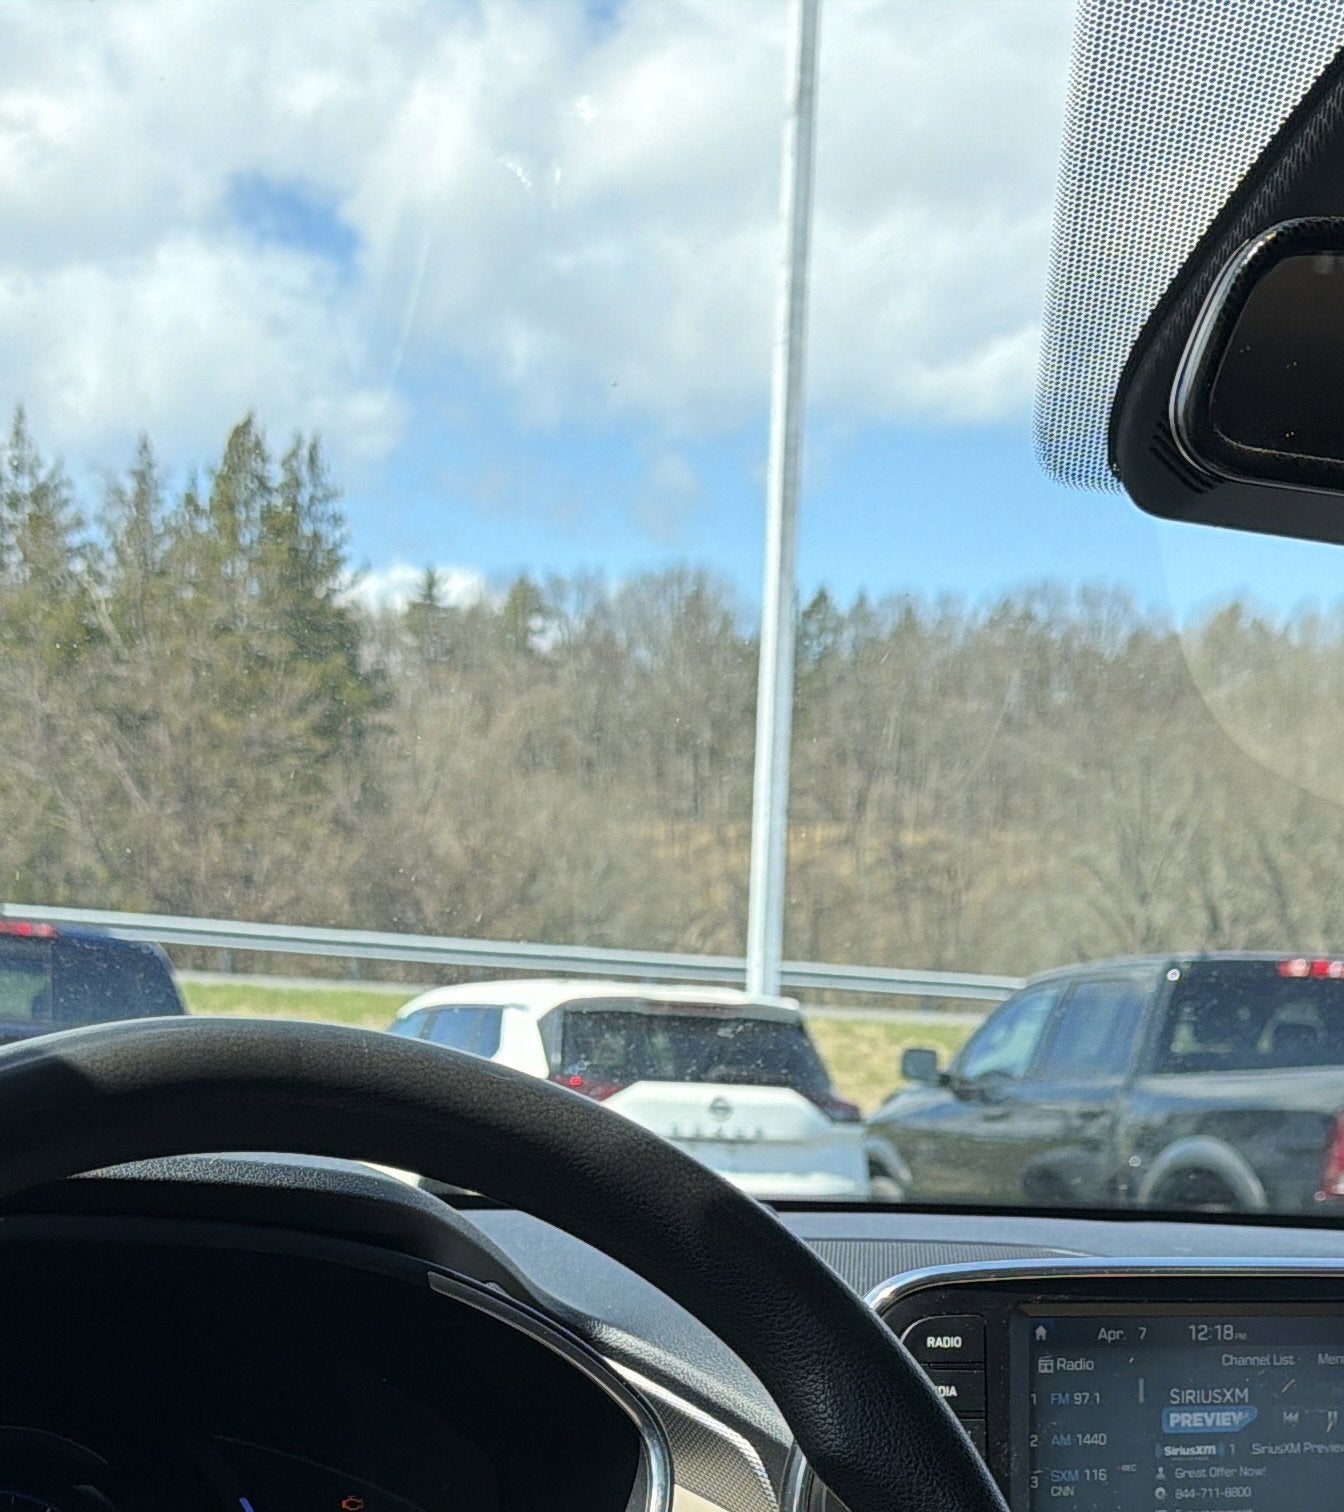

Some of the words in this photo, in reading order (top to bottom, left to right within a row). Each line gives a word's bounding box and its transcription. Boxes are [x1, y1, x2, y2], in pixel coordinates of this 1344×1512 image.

[1097, 1327, 1127, 1343] Apr.
[1138, 1327, 1147, 1340] 7
[1189, 1325, 1234, 1341] 12:18
[927, 1336, 962, 1348] RADIO
[1056, 1357, 1095, 1371] Radio
[1221, 1353, 1270, 1366] Channel
[1273, 1353, 1295, 1366] List
[1030, 1393, 1037, 1405] 1
[1050, 1393, 1070, 1405] FM
[1073, 1393, 1101, 1405] 97.1
[1169, 1411, 1250, 1427] PREVIEW
[1030, 1435, 1038, 1447] 2
[1051, 1434, 1072, 1446] AM
[1076, 1433, 1107, 1446] 1440
[1251, 1443, 1301, 1455] SiriusXM
[1030, 1476, 1039, 1488] 3
[1050, 1471, 1079, 1482] SXM
[1084, 1469, 1107, 1481] 116
[1175, 1468, 1206, 1479] Great
[1209, 1467, 1237, 1478] Offer
[1050, 1486, 1074, 1497] CNN
